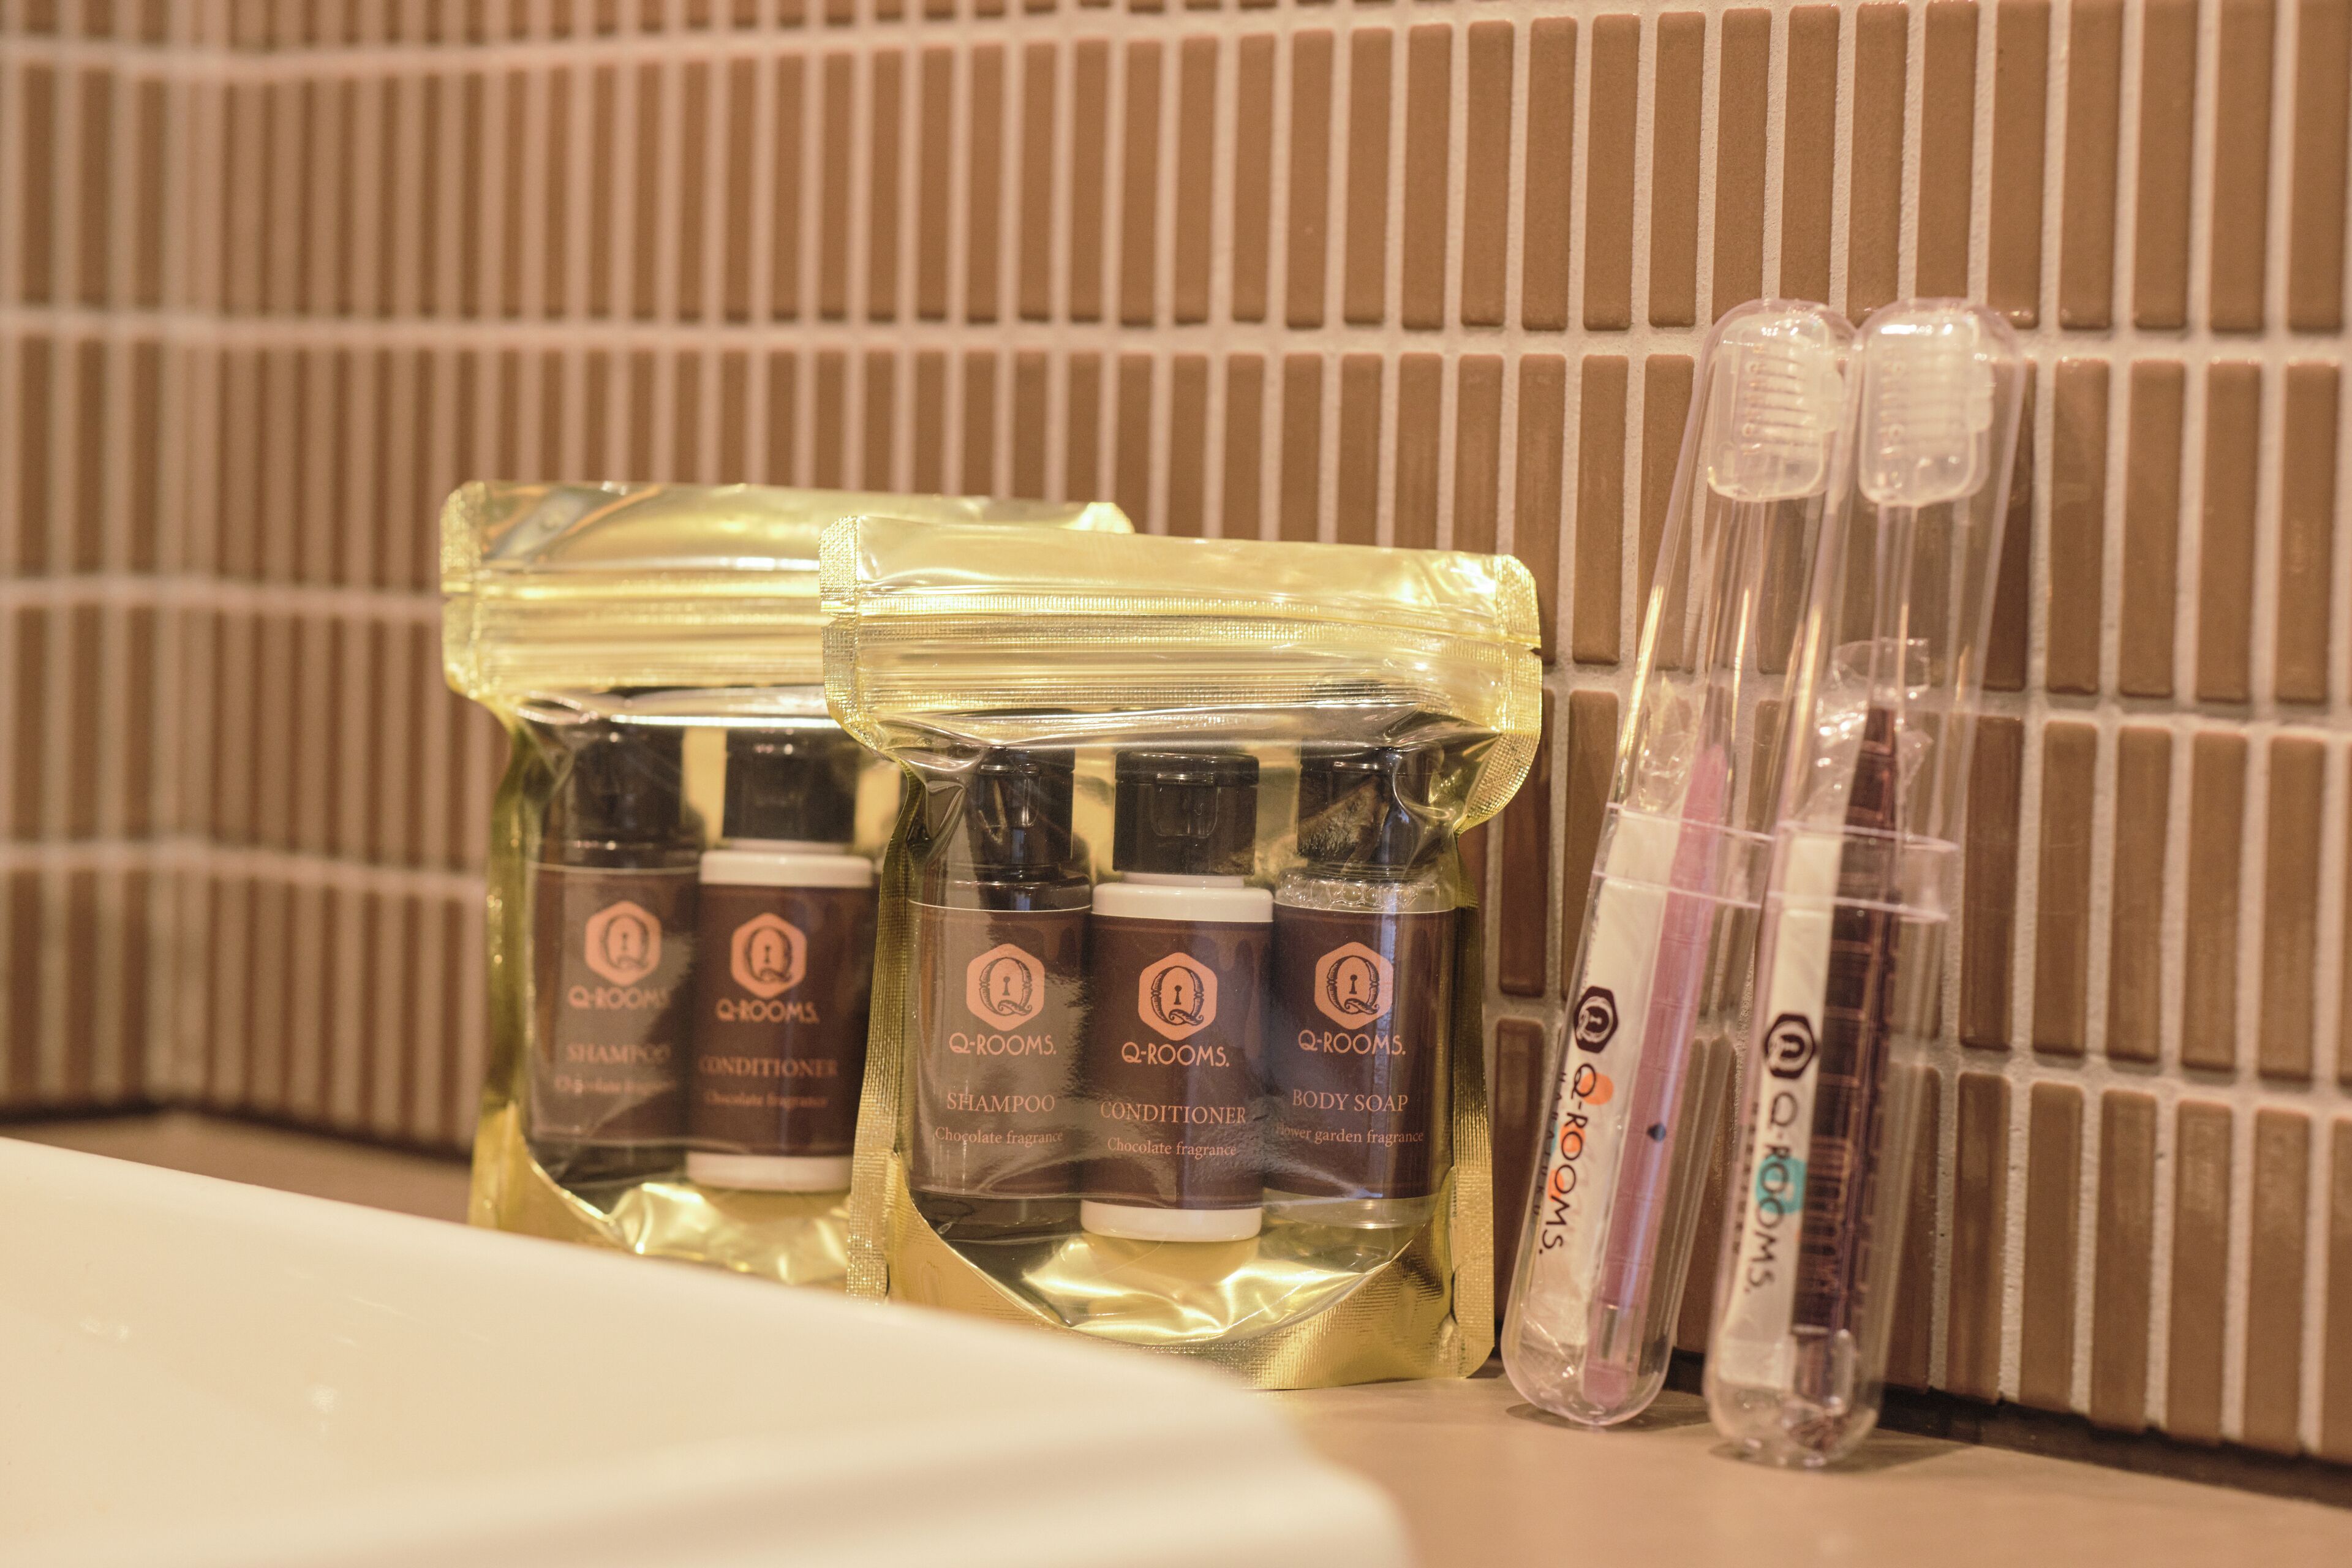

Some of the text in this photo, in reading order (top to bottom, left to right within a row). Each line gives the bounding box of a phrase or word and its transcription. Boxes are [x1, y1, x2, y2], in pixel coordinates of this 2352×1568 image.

[948, 1032, 1058, 1056] Q-ROOMS.
[1121, 1041, 1231, 1068] Q-ROOMS.
[1297, 1029, 1407, 1056] Q-ROOMS.
[946, 1092, 1055, 1114] SHAMPOO
[1292, 1088, 1409, 1113] BODY SOAP
[1100, 1101, 1246, 1125] CONDITIONER
[935, 1126, 1064, 1148] Chocolate fragrance
[1107, 1137, 1237, 1161] Chocolate fragrance
[1314, 1128, 1363, 1144] garden
[1366, 1129, 1425, 1147] fragrance
[1538, 1063, 1597, 1256] Q-ROOMS.
